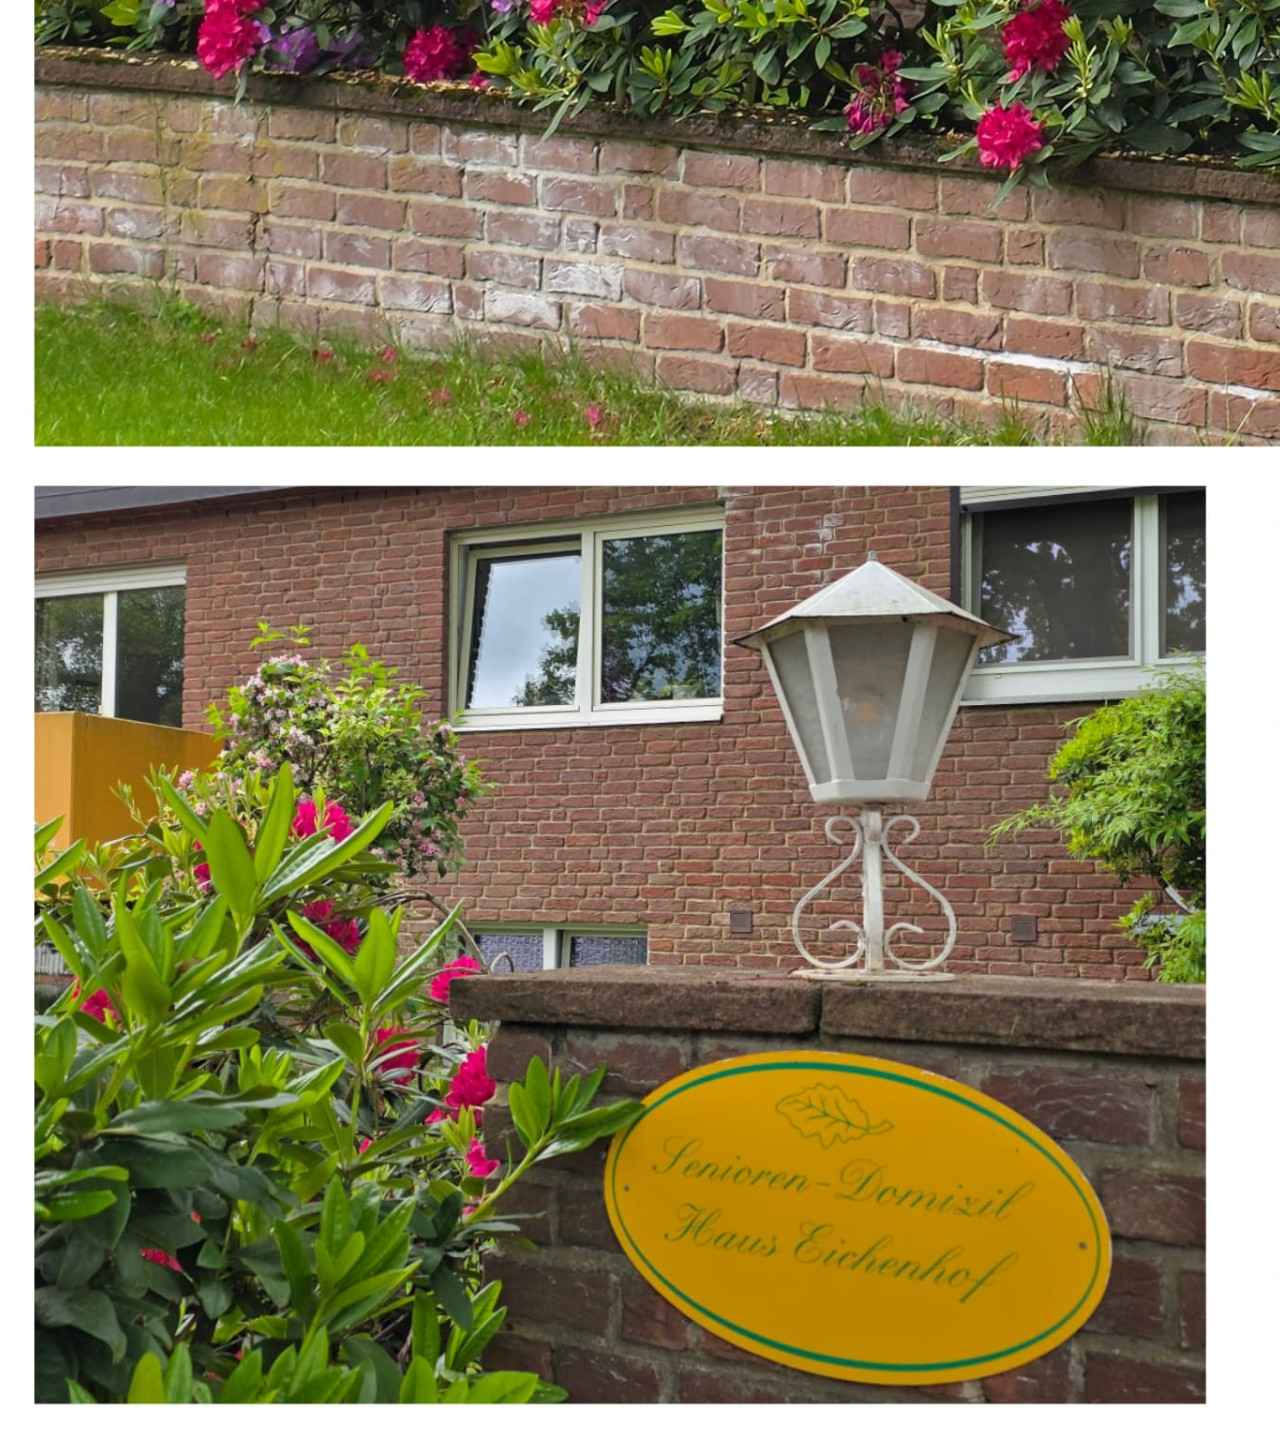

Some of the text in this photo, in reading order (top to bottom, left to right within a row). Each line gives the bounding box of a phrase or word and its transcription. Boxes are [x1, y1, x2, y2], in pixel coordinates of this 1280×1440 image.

[651, 1136, 1036, 1221] Senioren-Domizil
[663, 1202, 1019, 1304] Haus Eichenhof
